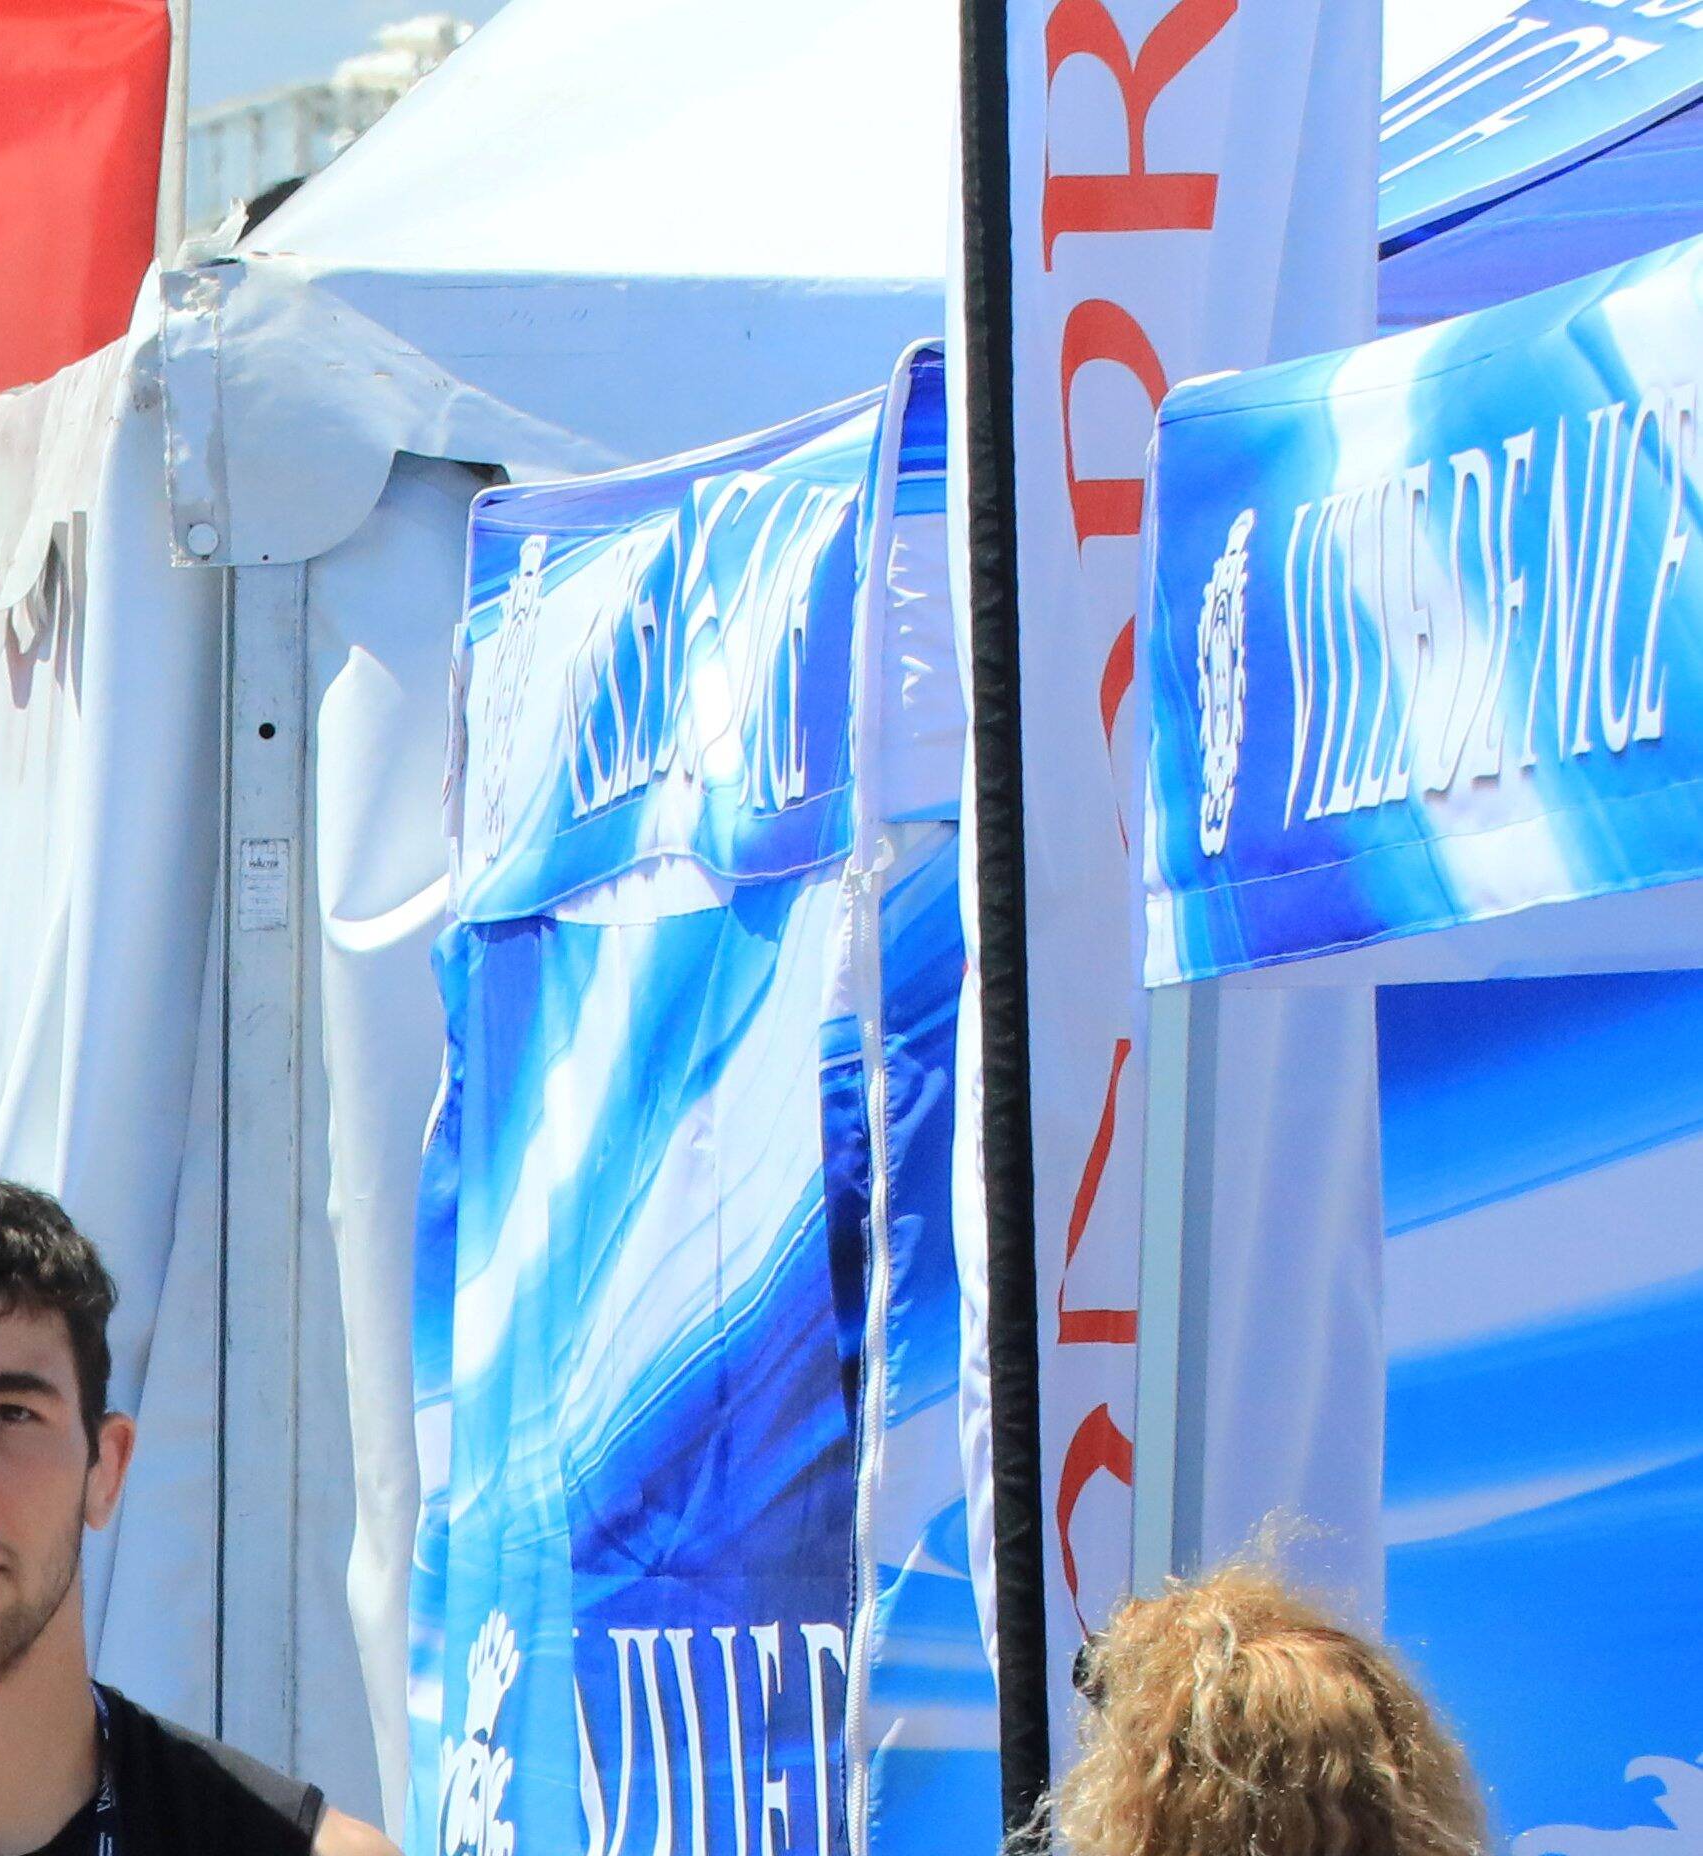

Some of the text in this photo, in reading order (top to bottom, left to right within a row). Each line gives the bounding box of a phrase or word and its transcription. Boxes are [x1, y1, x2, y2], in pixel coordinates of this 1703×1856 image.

[1284, 381, 1699, 831] VILLE DE NICE
